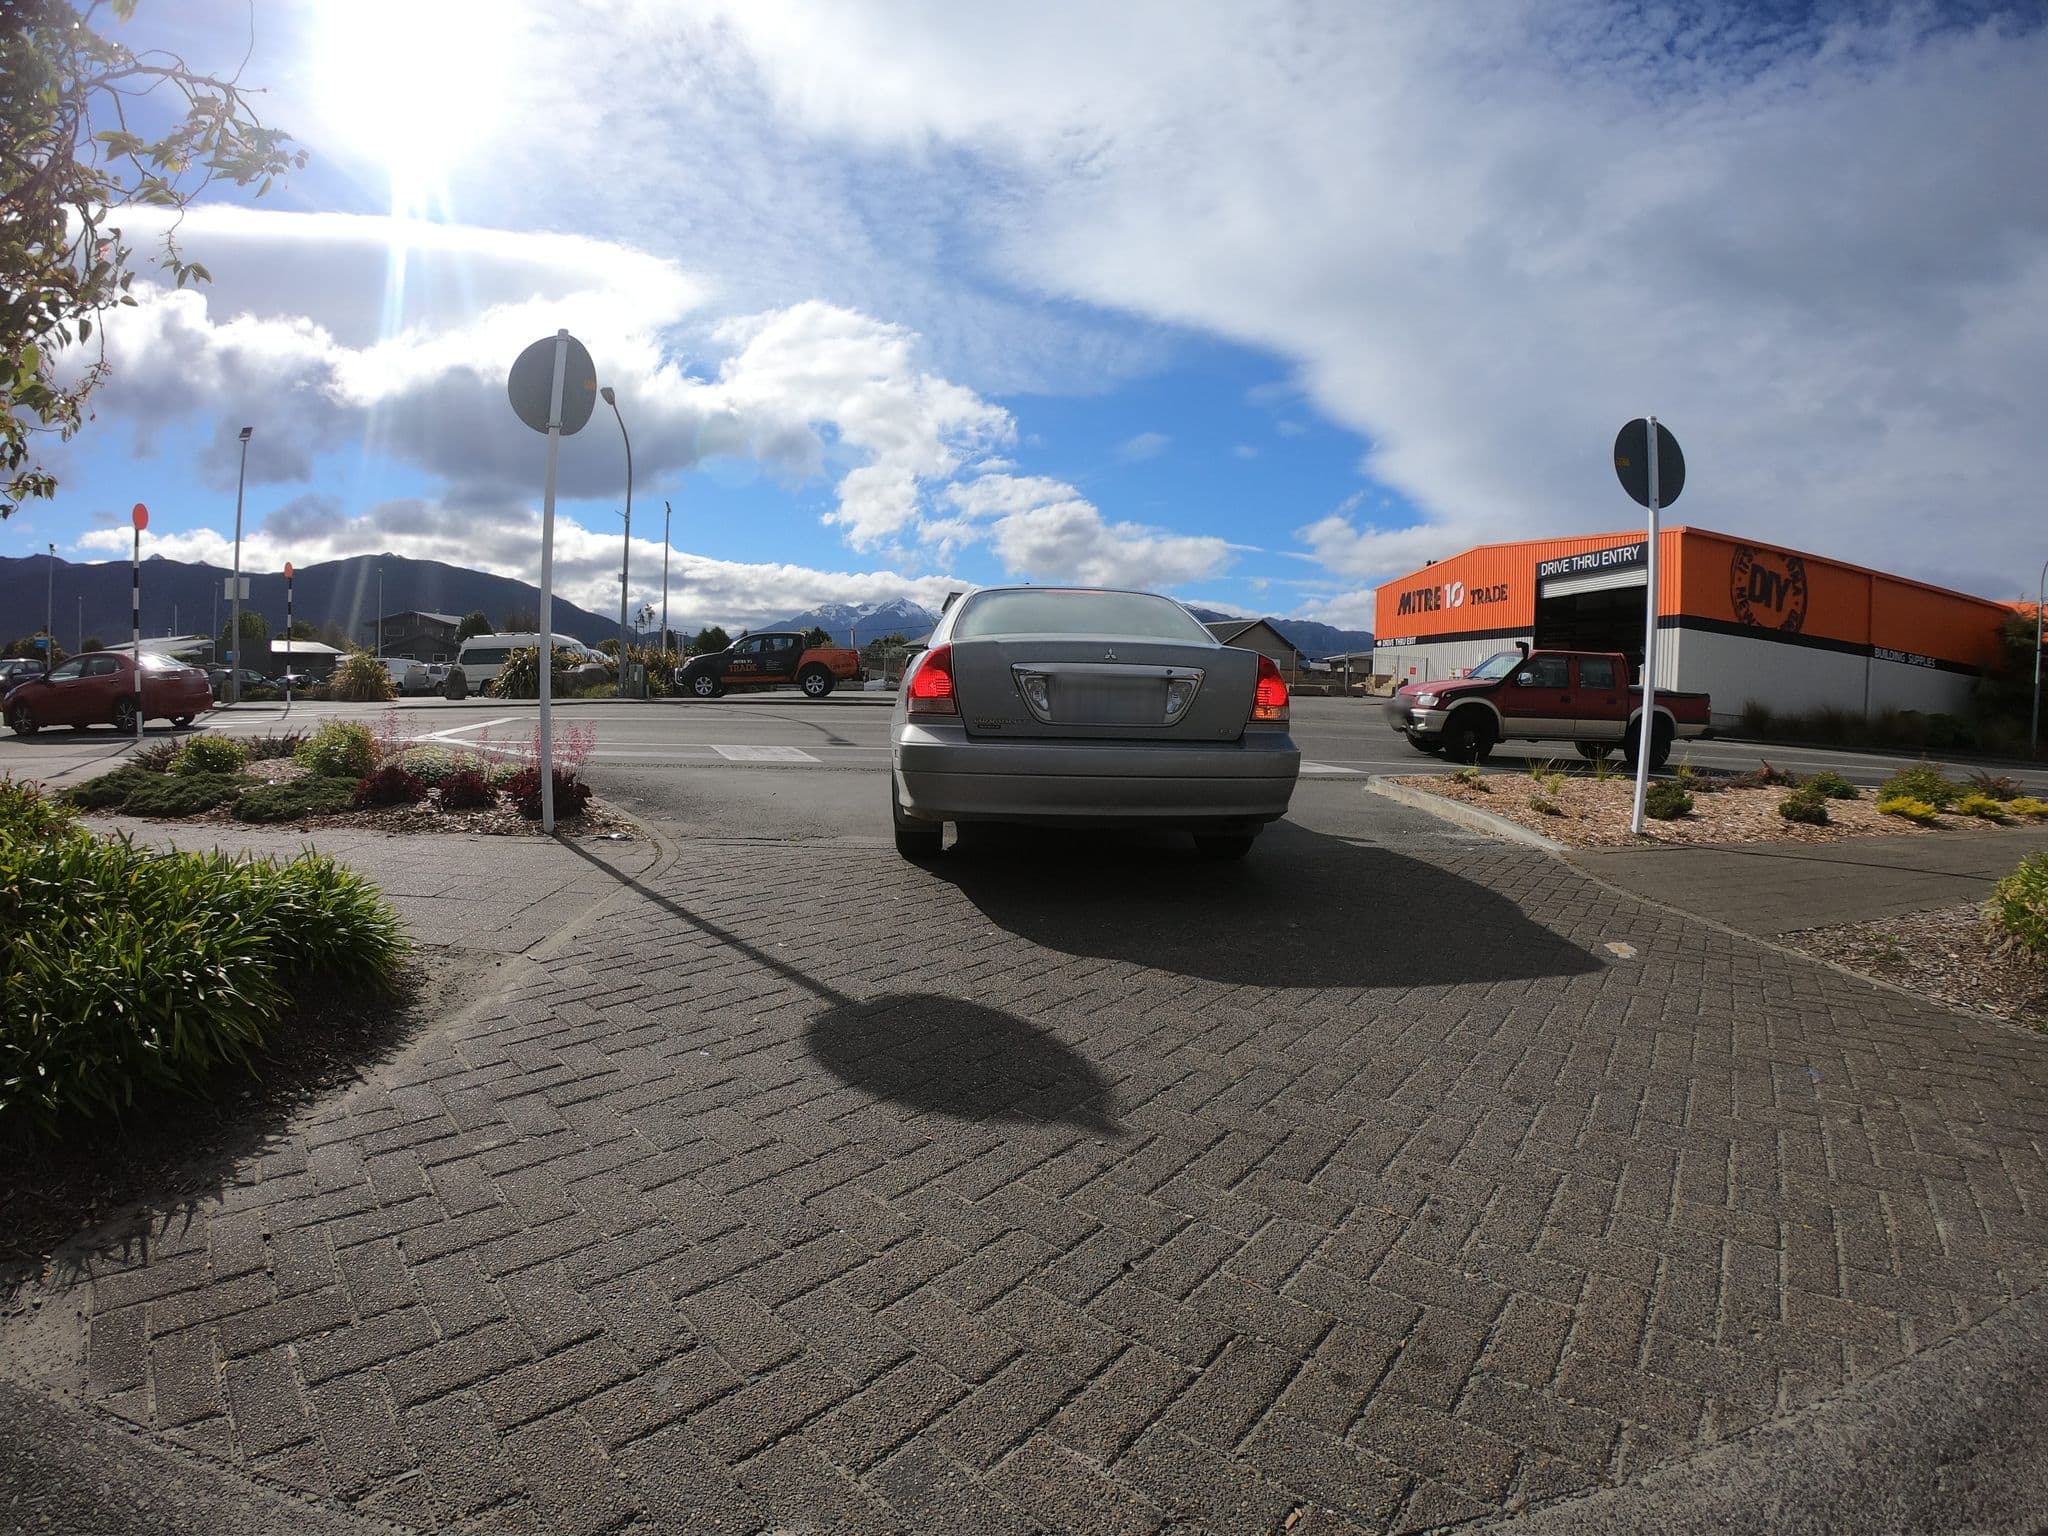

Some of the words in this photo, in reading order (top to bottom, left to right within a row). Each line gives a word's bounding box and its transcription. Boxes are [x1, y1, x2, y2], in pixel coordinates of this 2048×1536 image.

[1541, 558, 1570, 577] DRIVE
[1571, 553, 1600, 571] THRU
[1602, 544, 1640, 566] ENTRY
[1397, 586, 1441, 616] MITRE
[1445, 581, 1465, 609] 10
[1470, 583, 1508, 605] TRADE
[1748, 563, 1793, 613] DIY
[728, 663, 758, 672] TRADE
[1874, 647, 1908, 663] BUILDING
[1907, 653, 1937, 669] SUPPLIES
